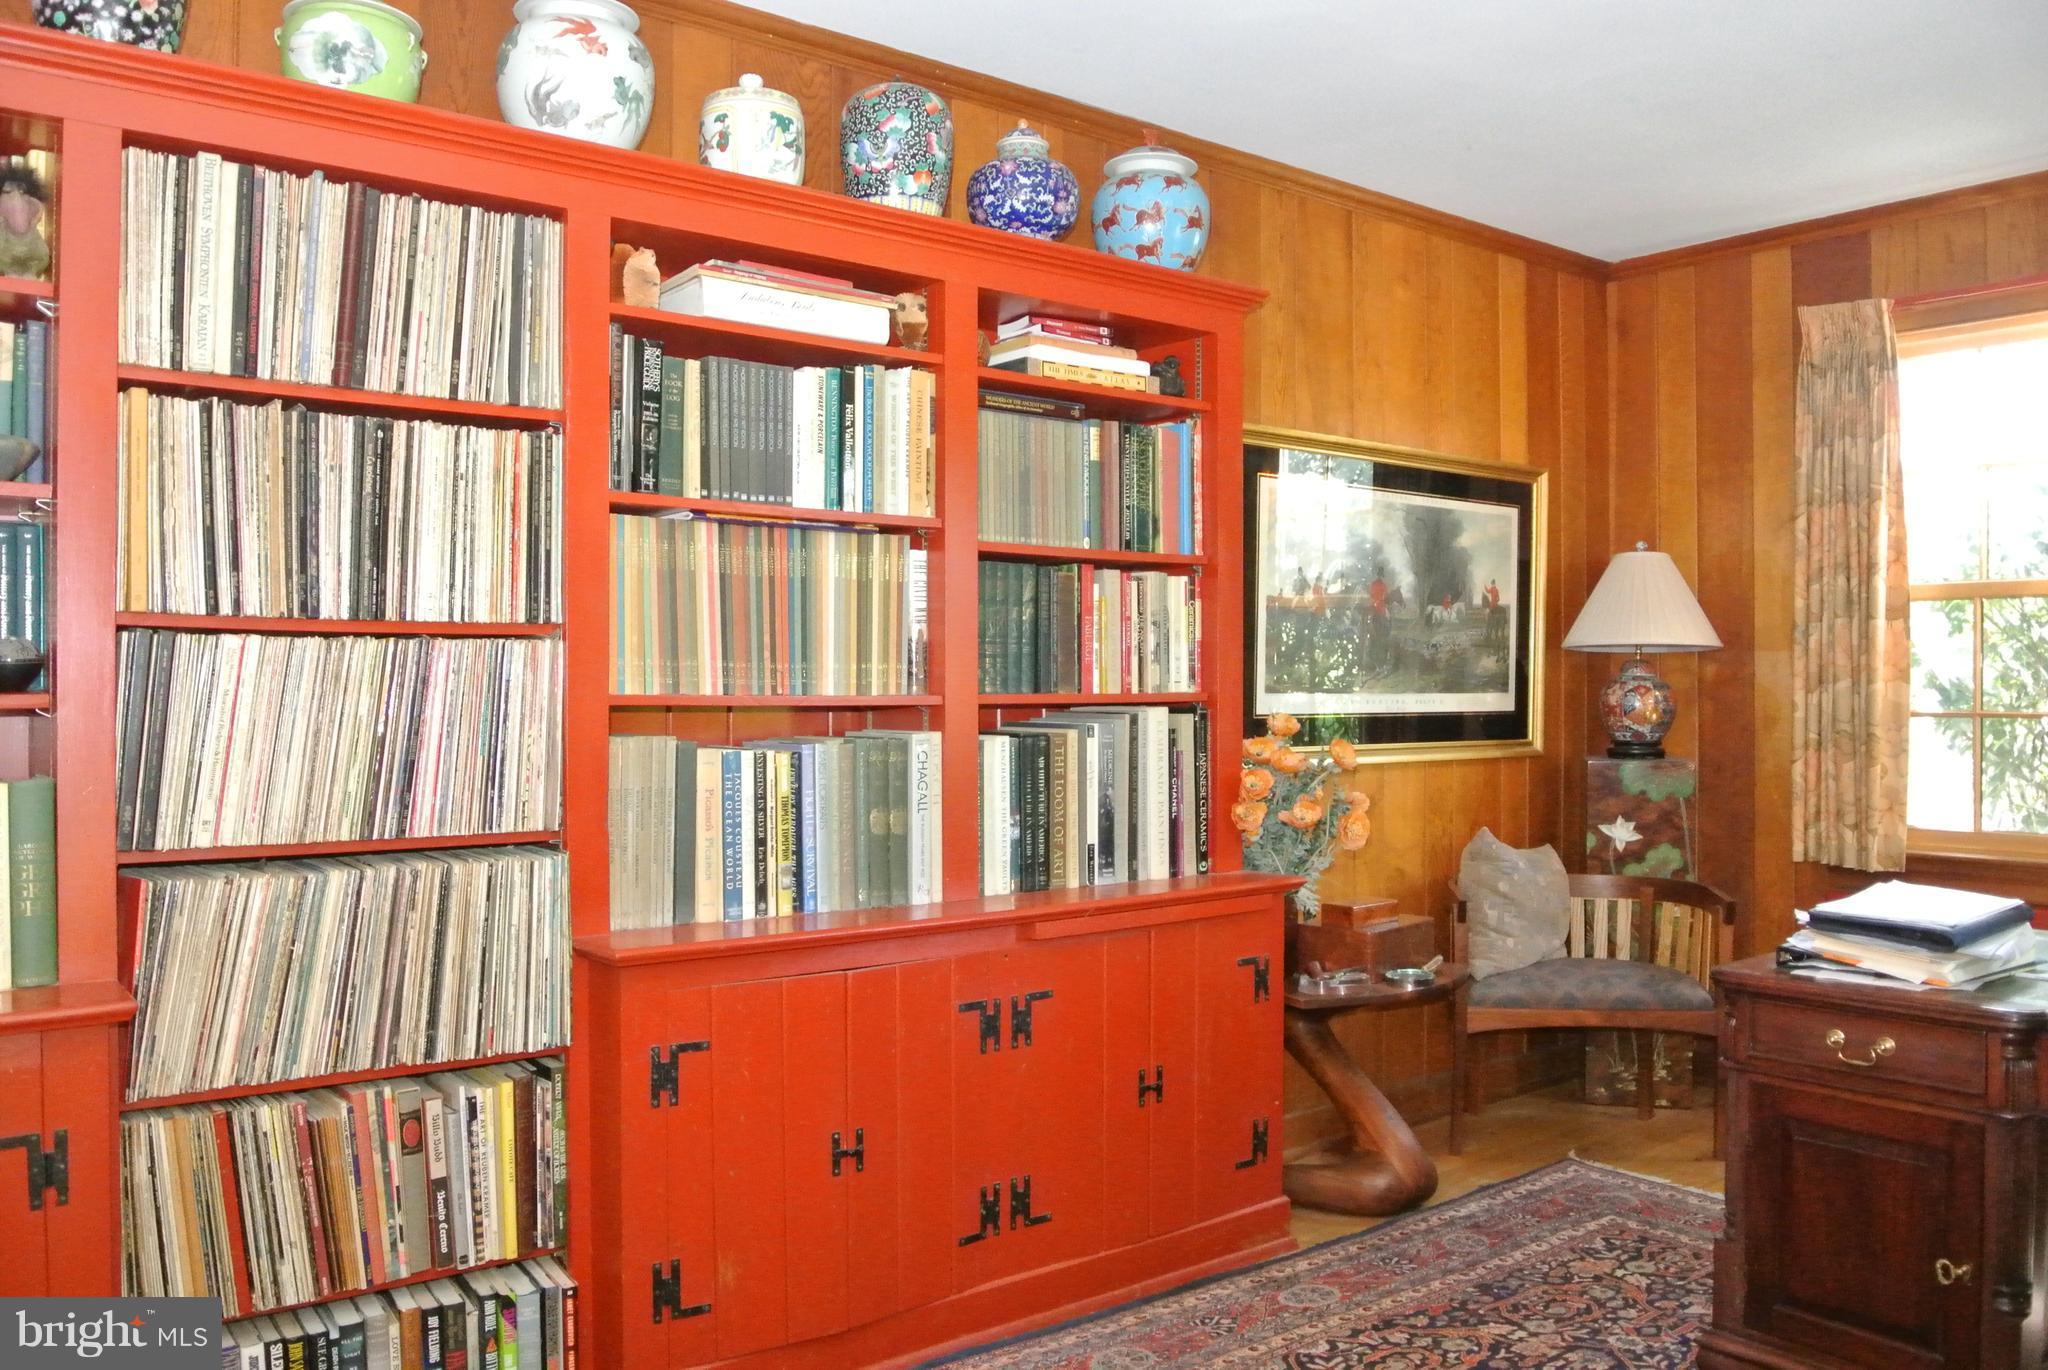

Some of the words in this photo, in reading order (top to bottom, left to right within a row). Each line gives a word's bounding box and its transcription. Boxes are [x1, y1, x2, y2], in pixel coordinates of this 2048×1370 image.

[202, 158, 217, 221] BEETHOVEN
[199, 228, 214, 298] SYMPHONIEN
[197, 304, 210, 350] KARAJAN
[643, 346, 651, 367] PRICE
[643, 367, 651, 391] GUIDE
[845, 404, 854, 427] Félix
[845, 428, 854, 469] Vallotton
[891, 435, 897, 446] OF
[23, 575, 33, 600] Pottery
[1054, 746, 1064, 777] THE
[1157, 720, 1165, 795] REMBRANDT
[725, 773, 733, 796] THE
[757, 753, 765, 798] INVESTING
[917, 750, 928, 814] CHAGALL
[1199, 752, 1207, 798] JAPANESE
[704, 788, 714, 832] Picasso's
[734, 773, 742, 822] JACQUES
[757, 800, 764, 809] IN
[781, 796, 790, 826] THOMAS
[806, 789, 815, 824] FIGHT
[1054, 780, 1064, 823] LOOM
[725, 803, 733, 842] OCEAN
[757, 811, 765, 839] SILVER
[1038, 816, 1045, 826] IN
[1054, 826, 1064, 844] OF
[1157, 801, 1165, 866] PAINTINGS
[1199, 799, 1207, 852] CERAMICS
[703, 837, 713, 880] Picassos
[781, 828, 790, 862] TOMPION
[726, 847, 734, 890] WORLD
[806, 838, 816, 897] SURVIVAL
[1054, 848, 1064, 877] ART
[432, 1139, 442, 1163] Budd
[480, 1138, 486, 1147] OF
[437, 1190, 448, 1221] Benito
[482, 1186, 490, 1219] KRAMER
[438, 1223, 449, 1253] Cereno
[428, 1316, 440, 1328] JOY
[484, 1300, 496, 1314] ANN
[566, 1298, 574, 1315] JANET
[484, 1315, 496, 1332] RULE
[288, 1341, 304, 1361] JOHN
[318, 1336, 327, 1355] SUE
[428, 1329, 440, 1363] FIELDING
